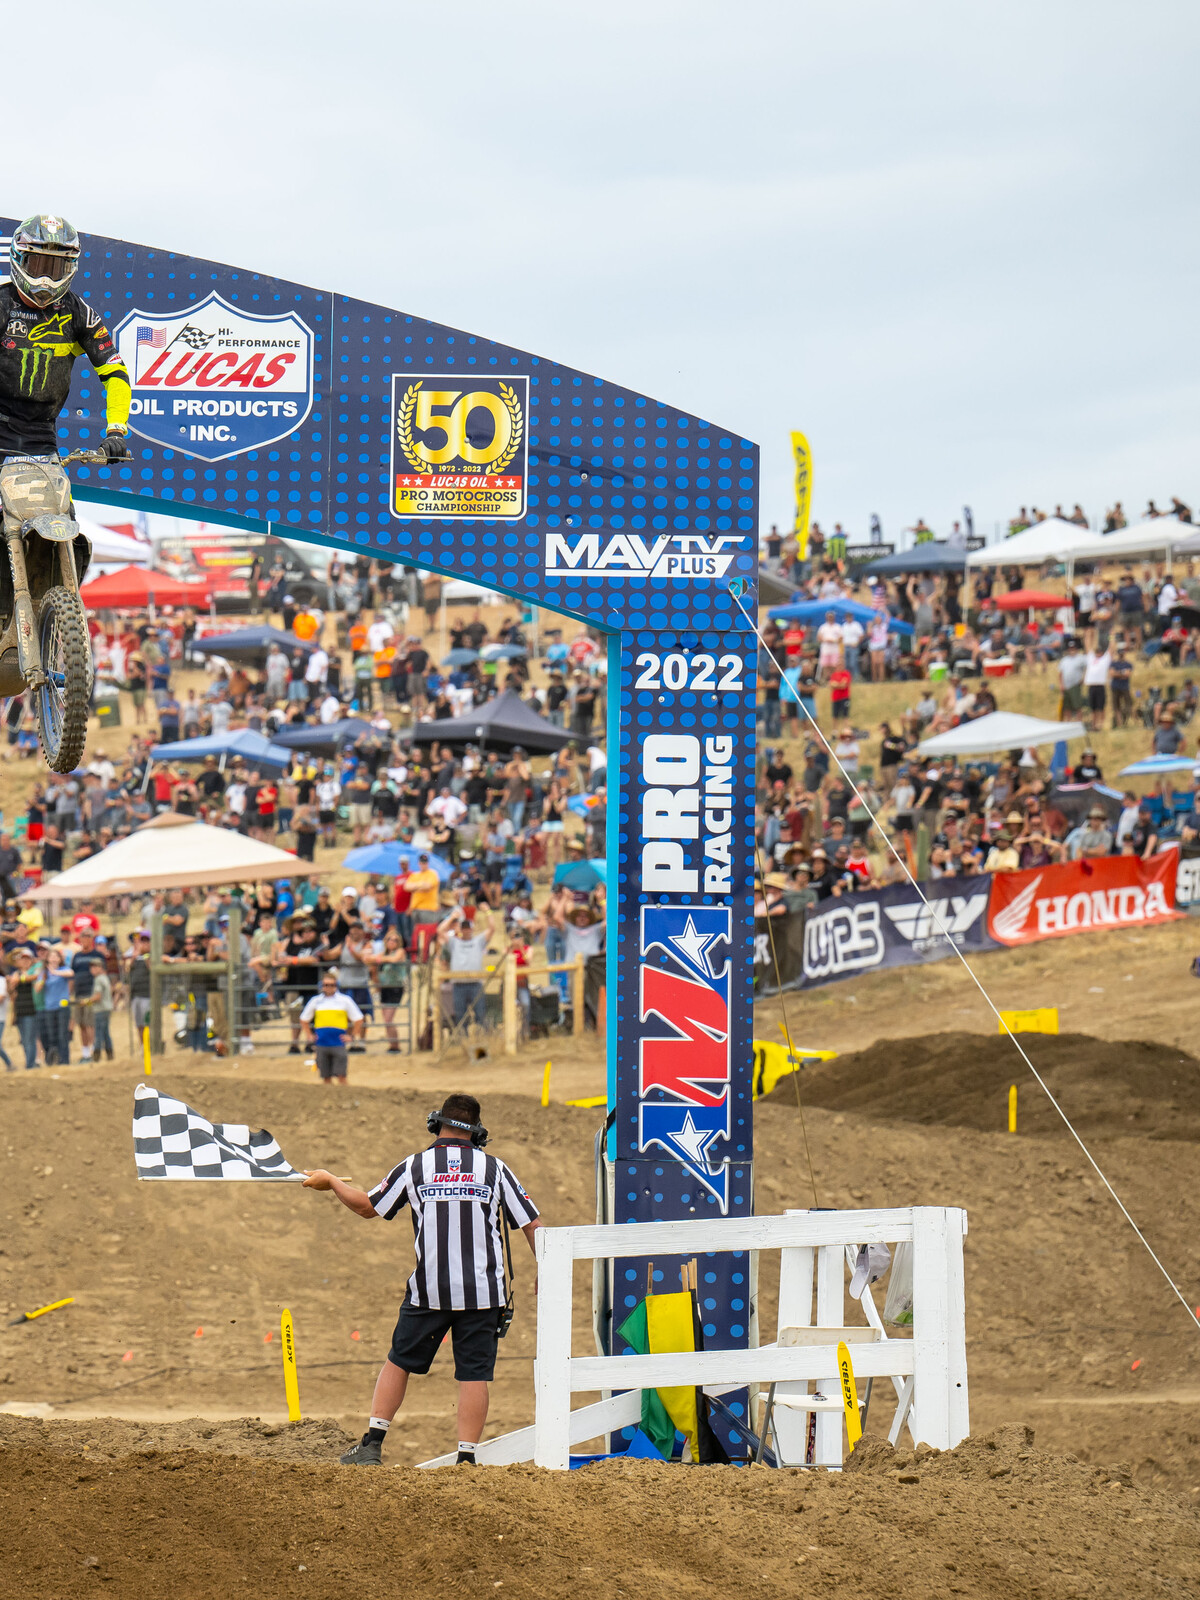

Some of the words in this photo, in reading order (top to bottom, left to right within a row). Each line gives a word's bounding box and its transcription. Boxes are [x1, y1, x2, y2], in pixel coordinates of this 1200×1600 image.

[218, 328, 234, 336] HI-
[218, 339, 301, 348] PERFORMANCE
[135, 351, 297, 388] LUCAS
[129, 399, 165, 415] OIL
[172, 400, 298, 418] PRODUCTS
[412, 390, 512, 465] 50
[438, 465, 456, 473] 1972
[430, 476, 468, 487] LUCAS
[469, 477, 488, 488] OIL
[400, 490, 429, 501] PRO
[432, 491, 518, 502] MOTOCROSS
[416, 503, 501, 512] CHAMPIONSHIP
[667, 555, 717, 575] PLUS
[634, 652, 744, 691] 2022
[641, 734, 700, 893] PRO
[704, 734, 734, 894] RACING
[1035, 881, 1171, 934] HONDA
[433, 1174, 460, 1183] LUCAS
[461, 1174, 474, 1183] OIL
[421, 1187, 489, 1199] MOTOCROSS
[285, 1324, 293, 1364] ACERBIS
[841, 1360, 853, 1410] ACERBIS
